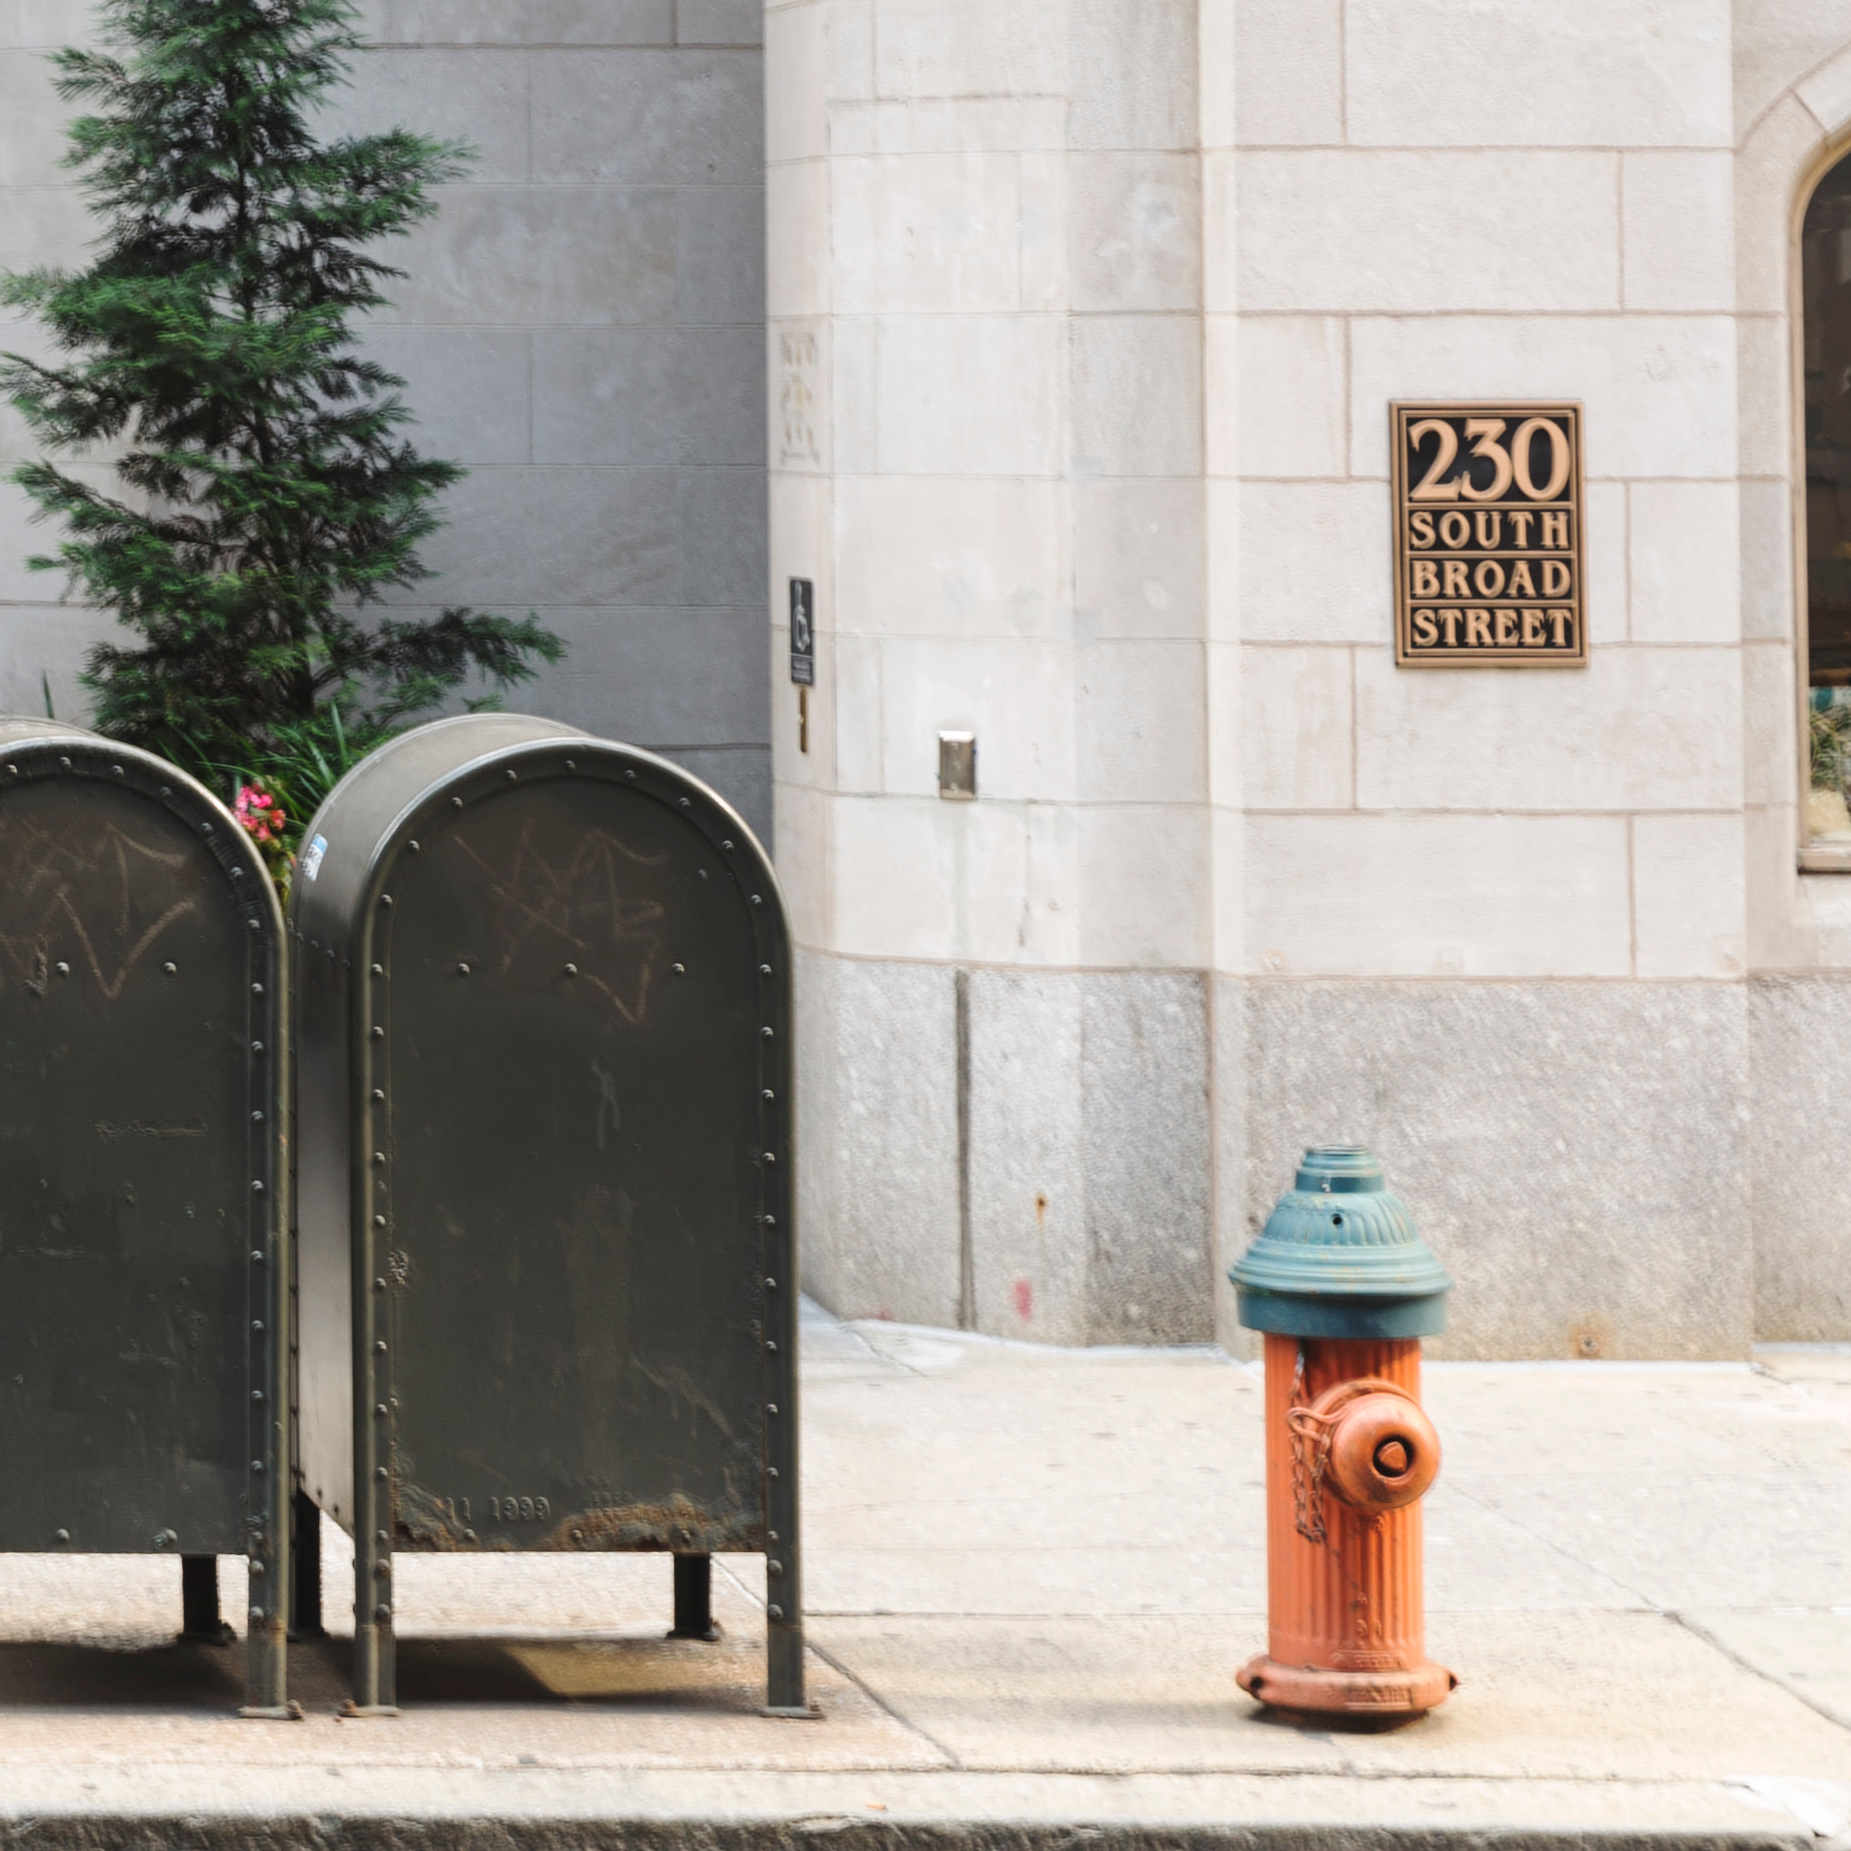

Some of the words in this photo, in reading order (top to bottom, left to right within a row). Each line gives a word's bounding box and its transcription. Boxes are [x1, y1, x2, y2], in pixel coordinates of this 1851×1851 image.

[1408, 417, 1571, 502] 230
[1409, 511, 1570, 550] SOUTH
[1411, 560, 1572, 599] BROAD
[1412, 609, 1573, 647] STREET
